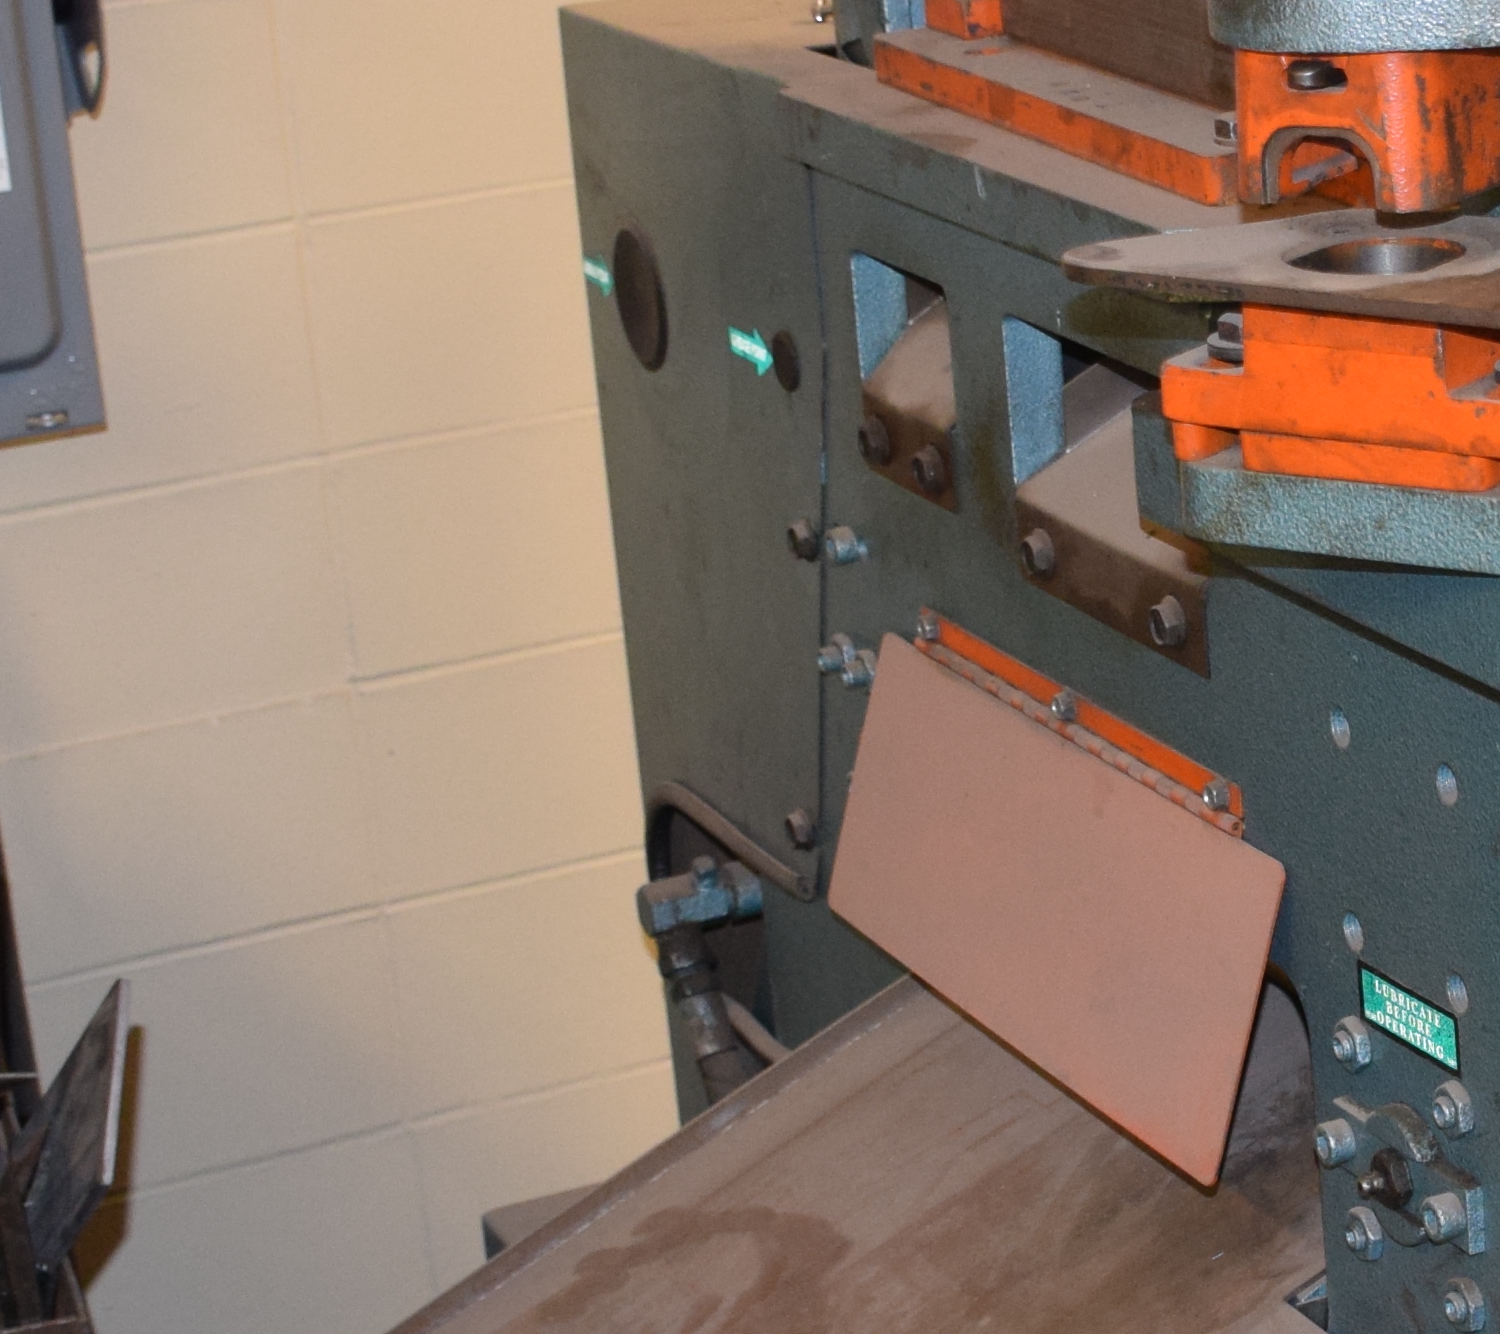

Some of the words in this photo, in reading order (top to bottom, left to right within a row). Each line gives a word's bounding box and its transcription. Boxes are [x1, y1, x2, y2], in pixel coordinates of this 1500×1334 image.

[1375, 979, 1442, 1028] LUBRICATE
[1385, 1000, 1432, 1037] BEFORE
[1377, 1011, 1444, 1059] OPERATING
